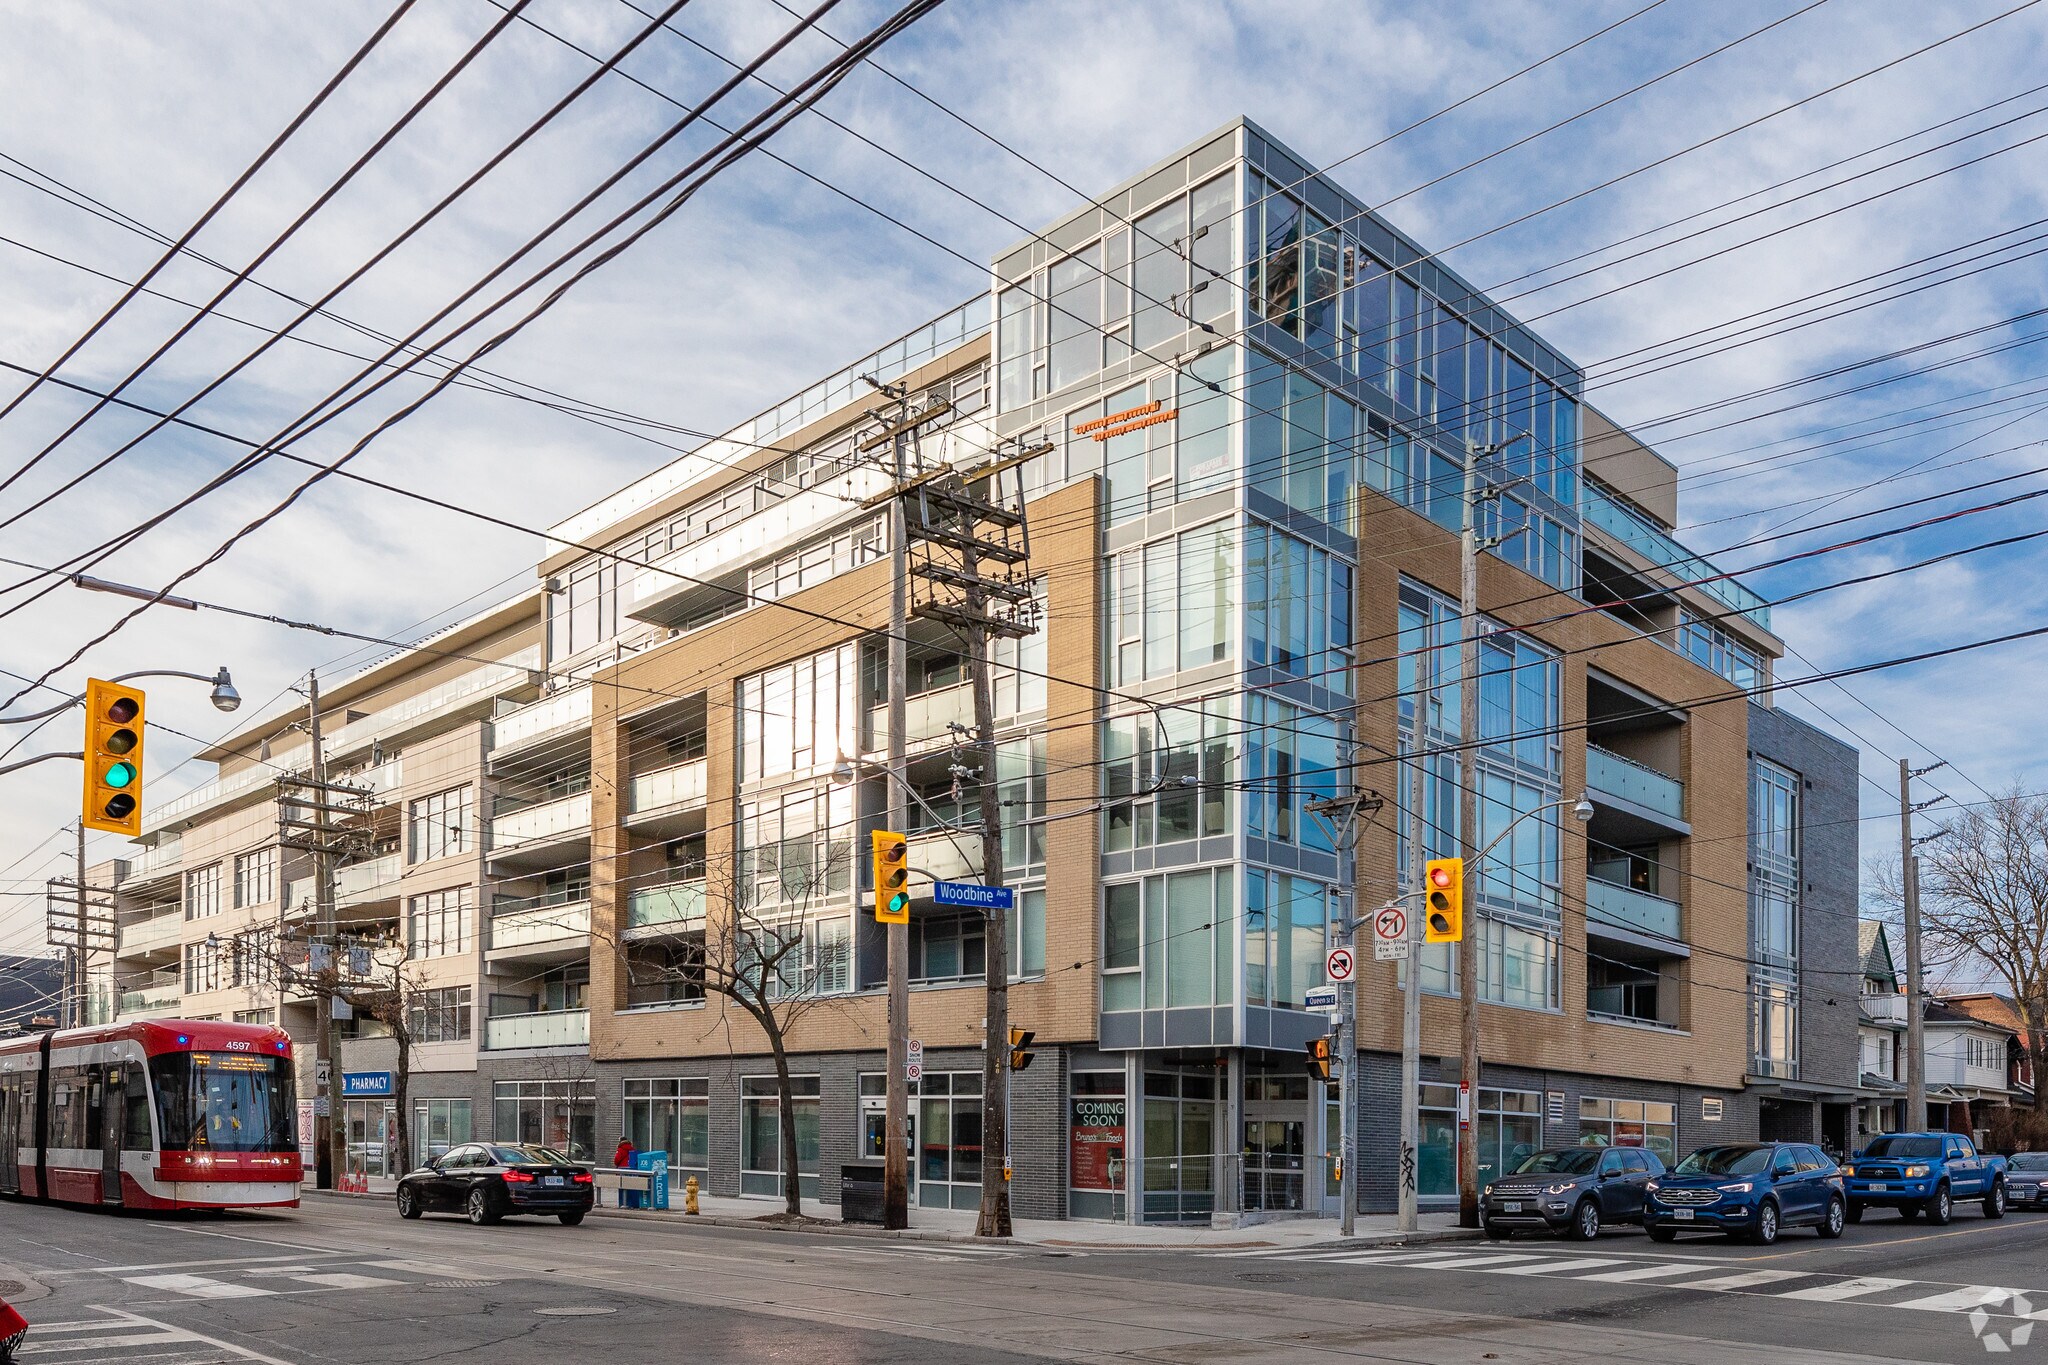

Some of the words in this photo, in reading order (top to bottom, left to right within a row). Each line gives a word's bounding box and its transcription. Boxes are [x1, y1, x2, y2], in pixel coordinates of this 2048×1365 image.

[940, 884, 993, 902] Woodbine
[1309, 997, 1325, 1005] Queen
[226, 1041, 250, 1050] 4597
[351, 1077, 387, 1090] PHARMACY
[1076, 1102, 1124, 1114] COMING
[1083, 1115, 1118, 1126] SOON
[1105, 1131, 1123, 1142] Foods
